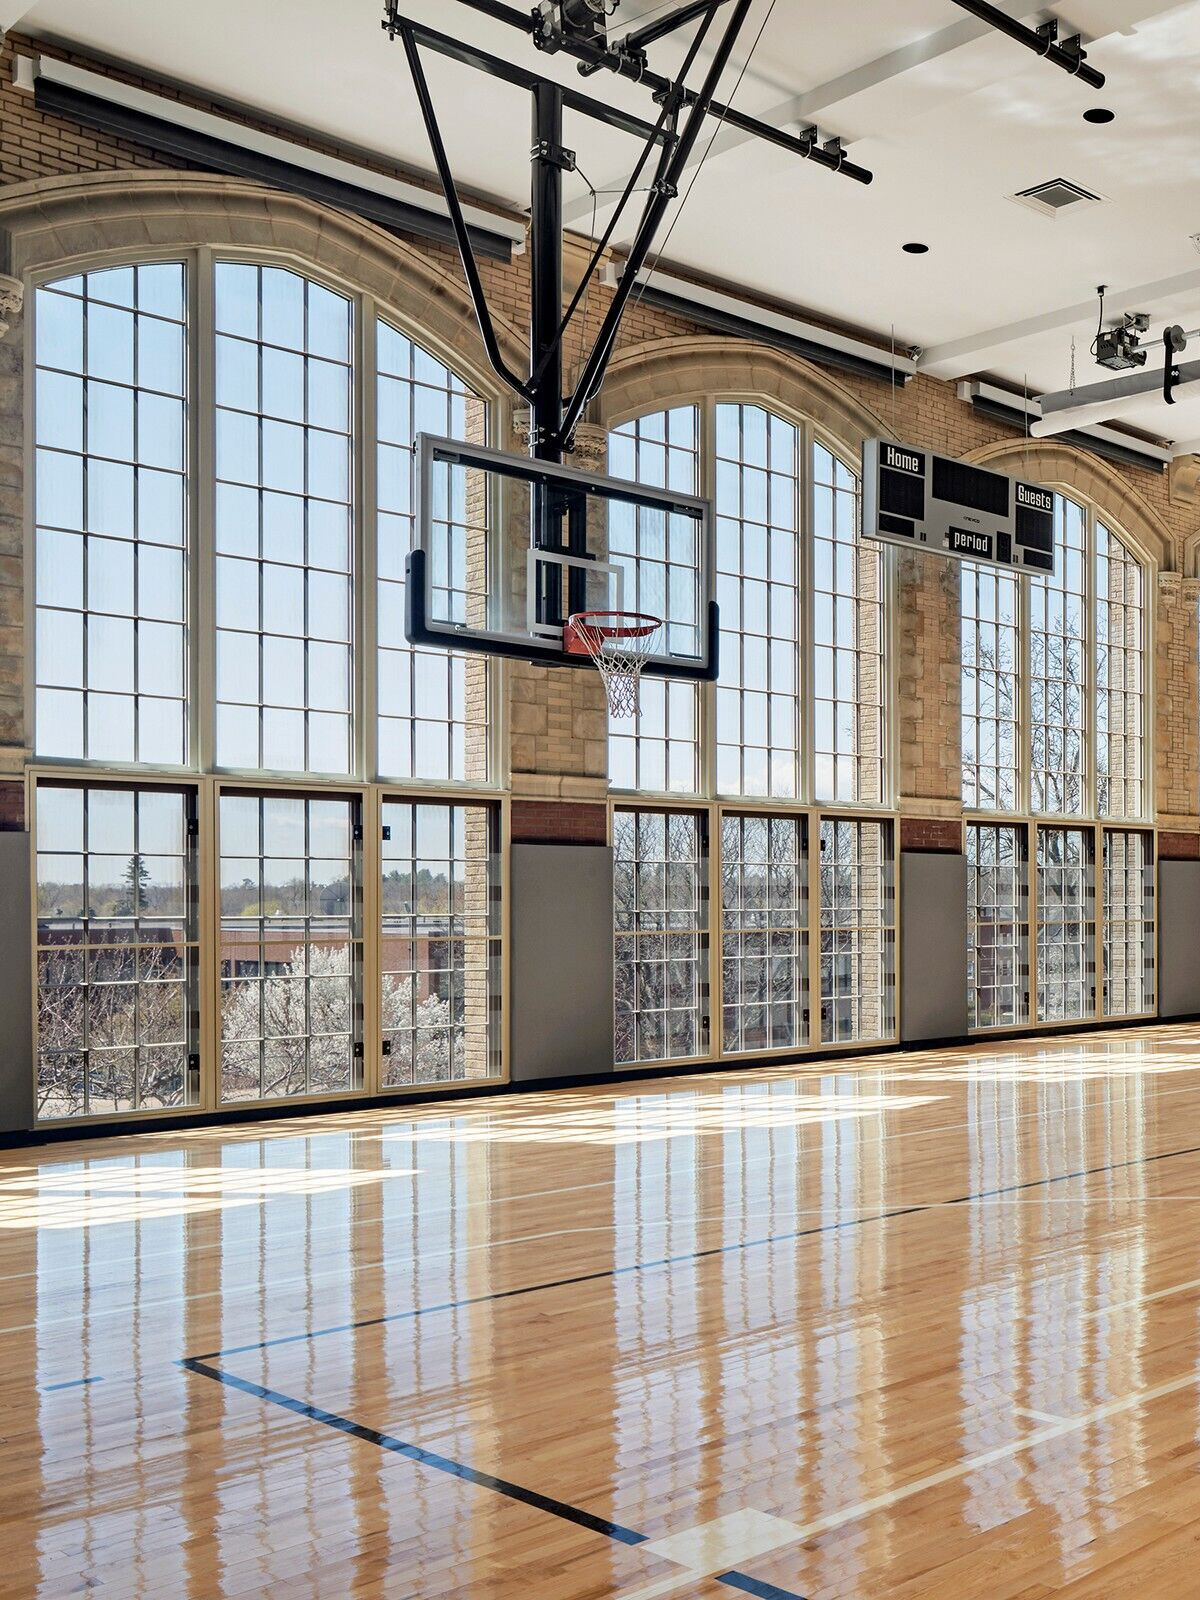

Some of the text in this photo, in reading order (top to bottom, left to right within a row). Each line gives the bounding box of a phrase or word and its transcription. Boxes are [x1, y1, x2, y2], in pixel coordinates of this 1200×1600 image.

[887, 446, 919, 472] Home
[1017, 484, 1051, 509] Guests
[954, 531, 988, 552] period
